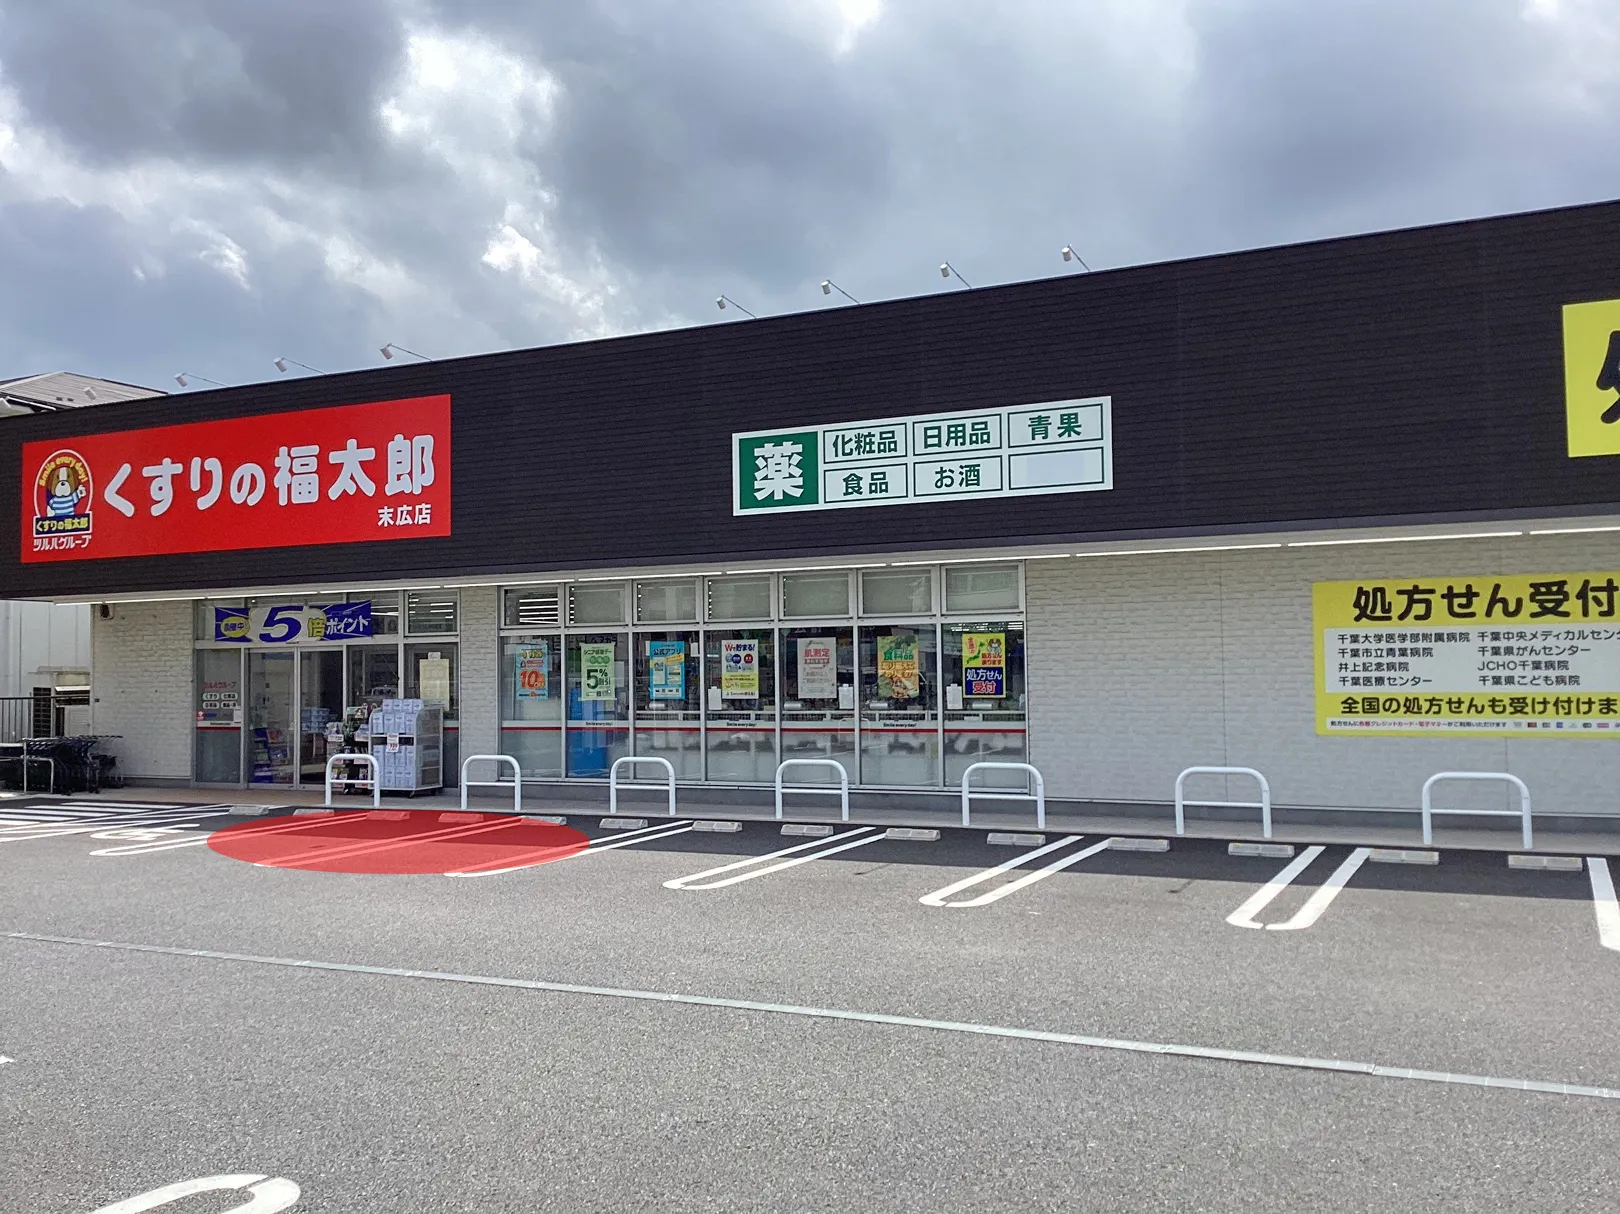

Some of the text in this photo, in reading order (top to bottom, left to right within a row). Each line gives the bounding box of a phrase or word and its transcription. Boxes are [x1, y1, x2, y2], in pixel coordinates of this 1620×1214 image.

[923, 422, 991, 448] 日用品
[1028, 412, 1082, 440] 青果
[832, 430, 898, 457] 化粧品
[104, 434, 434, 517] くすりの福太郎
[754, 442, 804, 501] 薬
[934, 464, 981, 489] お酒
[842, 471, 890, 495] 食品
[36, 517, 89, 532] くすりの福太郎
[378, 503, 432, 527] 末広店
[33, 535, 92, 551] ツルハグループ
[1352, 577, 1620, 622] 処方せん受付
[1336, 631, 1470, 645] 千葉大学医学部附属病院
[1337, 644, 1591, 659] 千葉市立青葉病院 千葉県がんセンター
[966, 669, 1003, 681] 処方せん
[1337, 660, 1569, 673] 井上記念病院 JCHO千葉病院
[973, 681, 996, 694] 受付
[1337, 675, 1580, 687] 千葉医療センター 千葉県こども病院
[1339, 695, 1619, 716] 全国の処方せんも受け付けま
